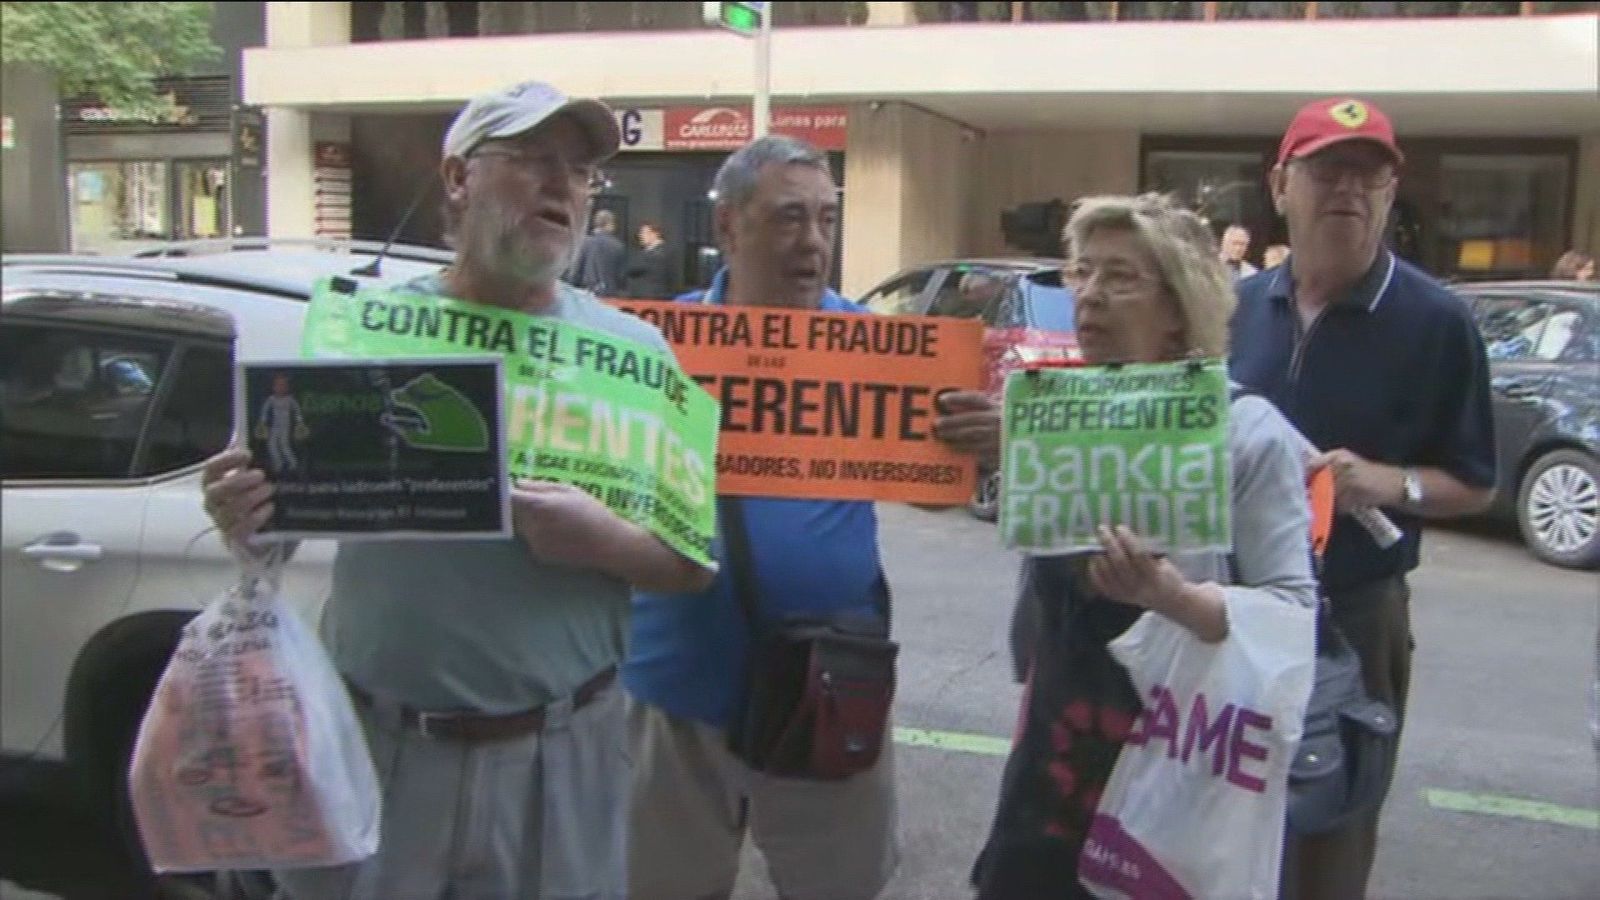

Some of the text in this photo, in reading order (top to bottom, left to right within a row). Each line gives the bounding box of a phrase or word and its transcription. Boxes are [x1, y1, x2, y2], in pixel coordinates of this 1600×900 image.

[361, 299, 516, 353] CONTRA
[526, 326, 566, 364] EL
[575, 336, 689, 415] FRAUDE
[760, 313, 799, 349] EL
[807, 317, 938, 357] FRAUDE
[1009, 396, 1218, 433] PREFERENTES
[808, 459, 837, 480] NO
[839, 459, 964, 486] INVERSORES!
[1008, 438, 1217, 494] Bankia
[1005, 491, 1219, 549] FRAUDE!
